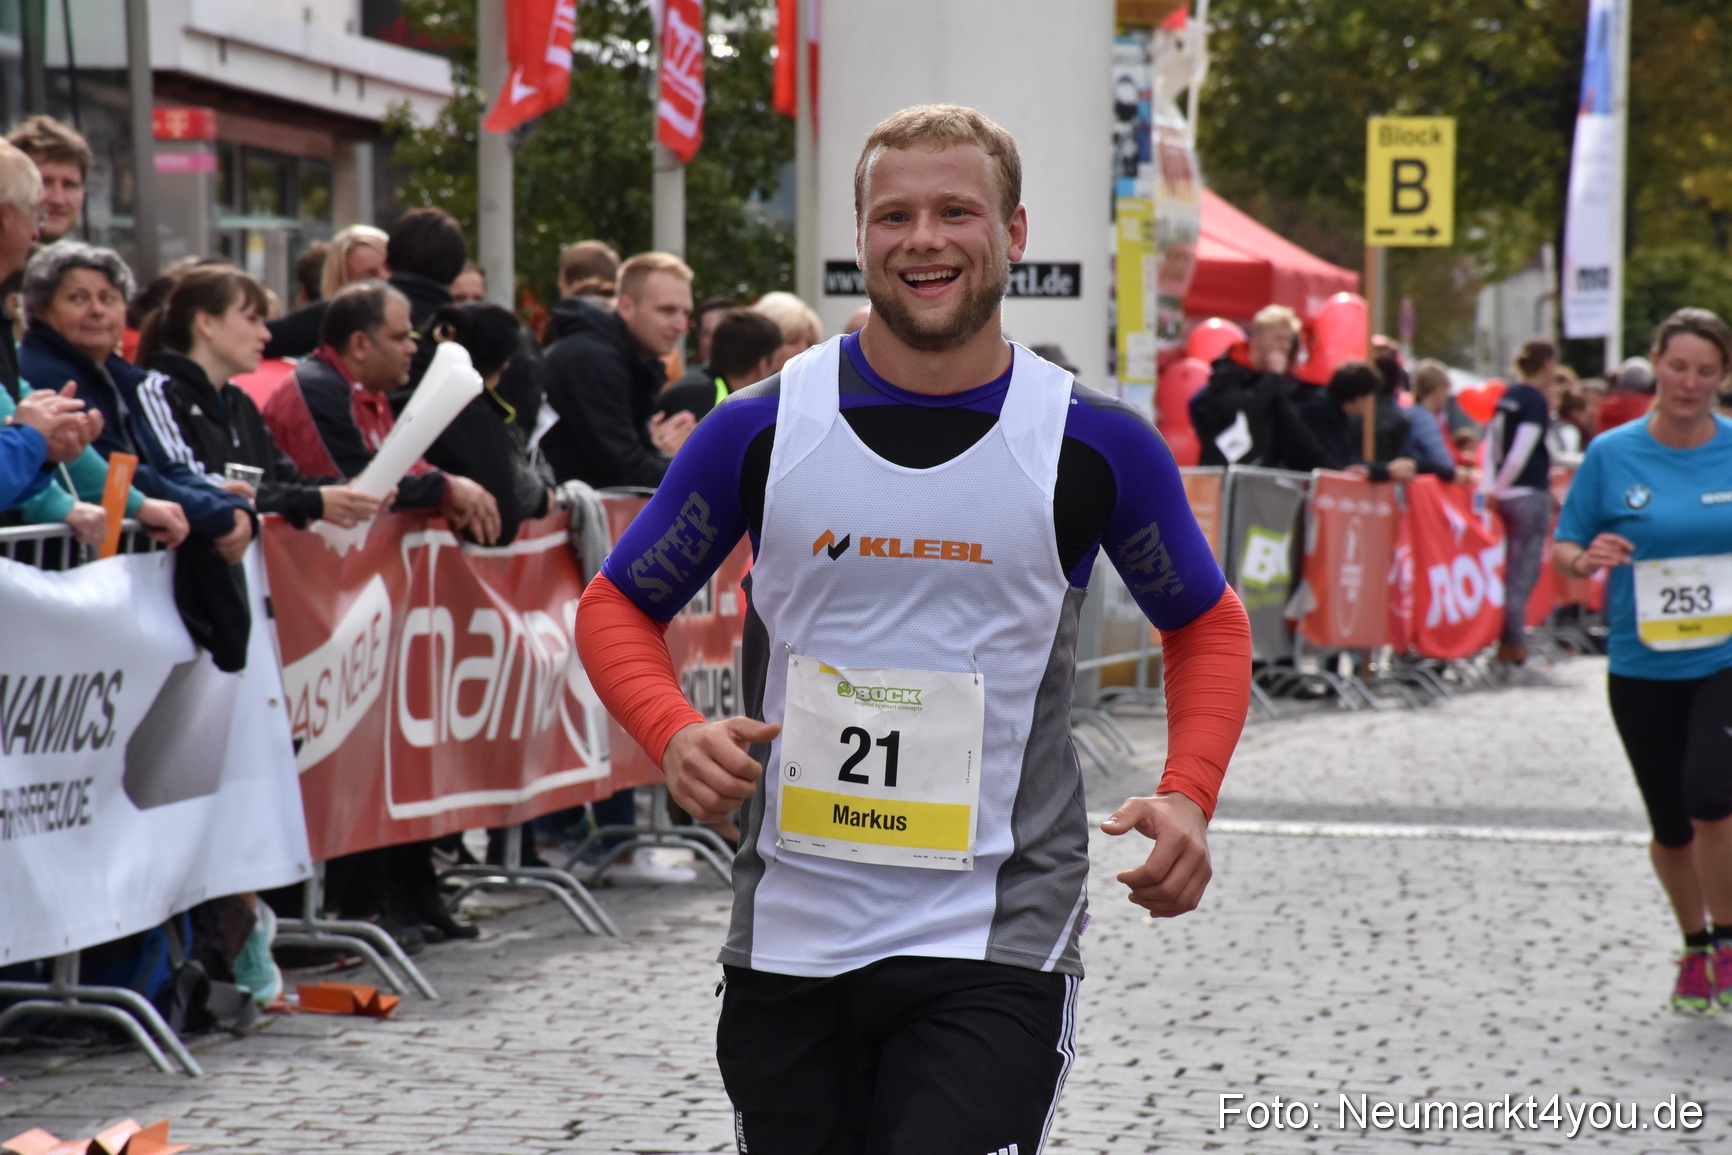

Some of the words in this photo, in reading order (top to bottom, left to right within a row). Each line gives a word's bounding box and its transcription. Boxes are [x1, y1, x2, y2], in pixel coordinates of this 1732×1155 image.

[1379, 125, 1443, 147] Block
[1390, 158, 1429, 214] B
[627, 491, 719, 603] STEP
[859, 536, 993, 564] KLEBL
[1661, 584, 1713, 615] 253
[853, 685, 922, 706] BOCK
[838, 726, 900, 787] 21
[789, 766, 797, 777] D
[832, 803, 908, 831] Markus
